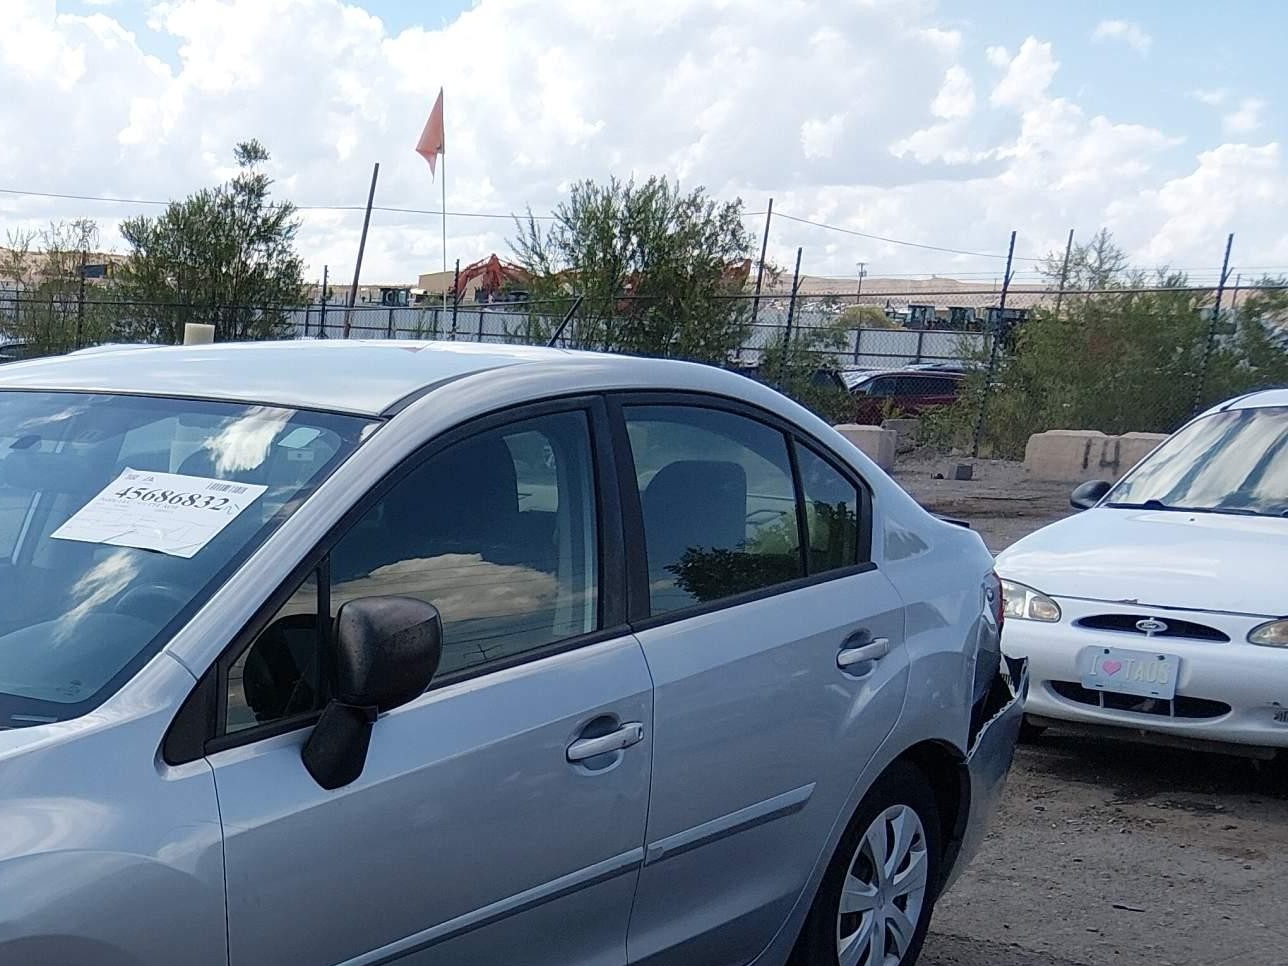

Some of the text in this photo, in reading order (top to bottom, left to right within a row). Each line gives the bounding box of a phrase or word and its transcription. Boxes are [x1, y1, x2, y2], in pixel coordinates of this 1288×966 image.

[115, 486, 230, 511] 45686832
[1089, 655, 1169, 684] I TAOS
